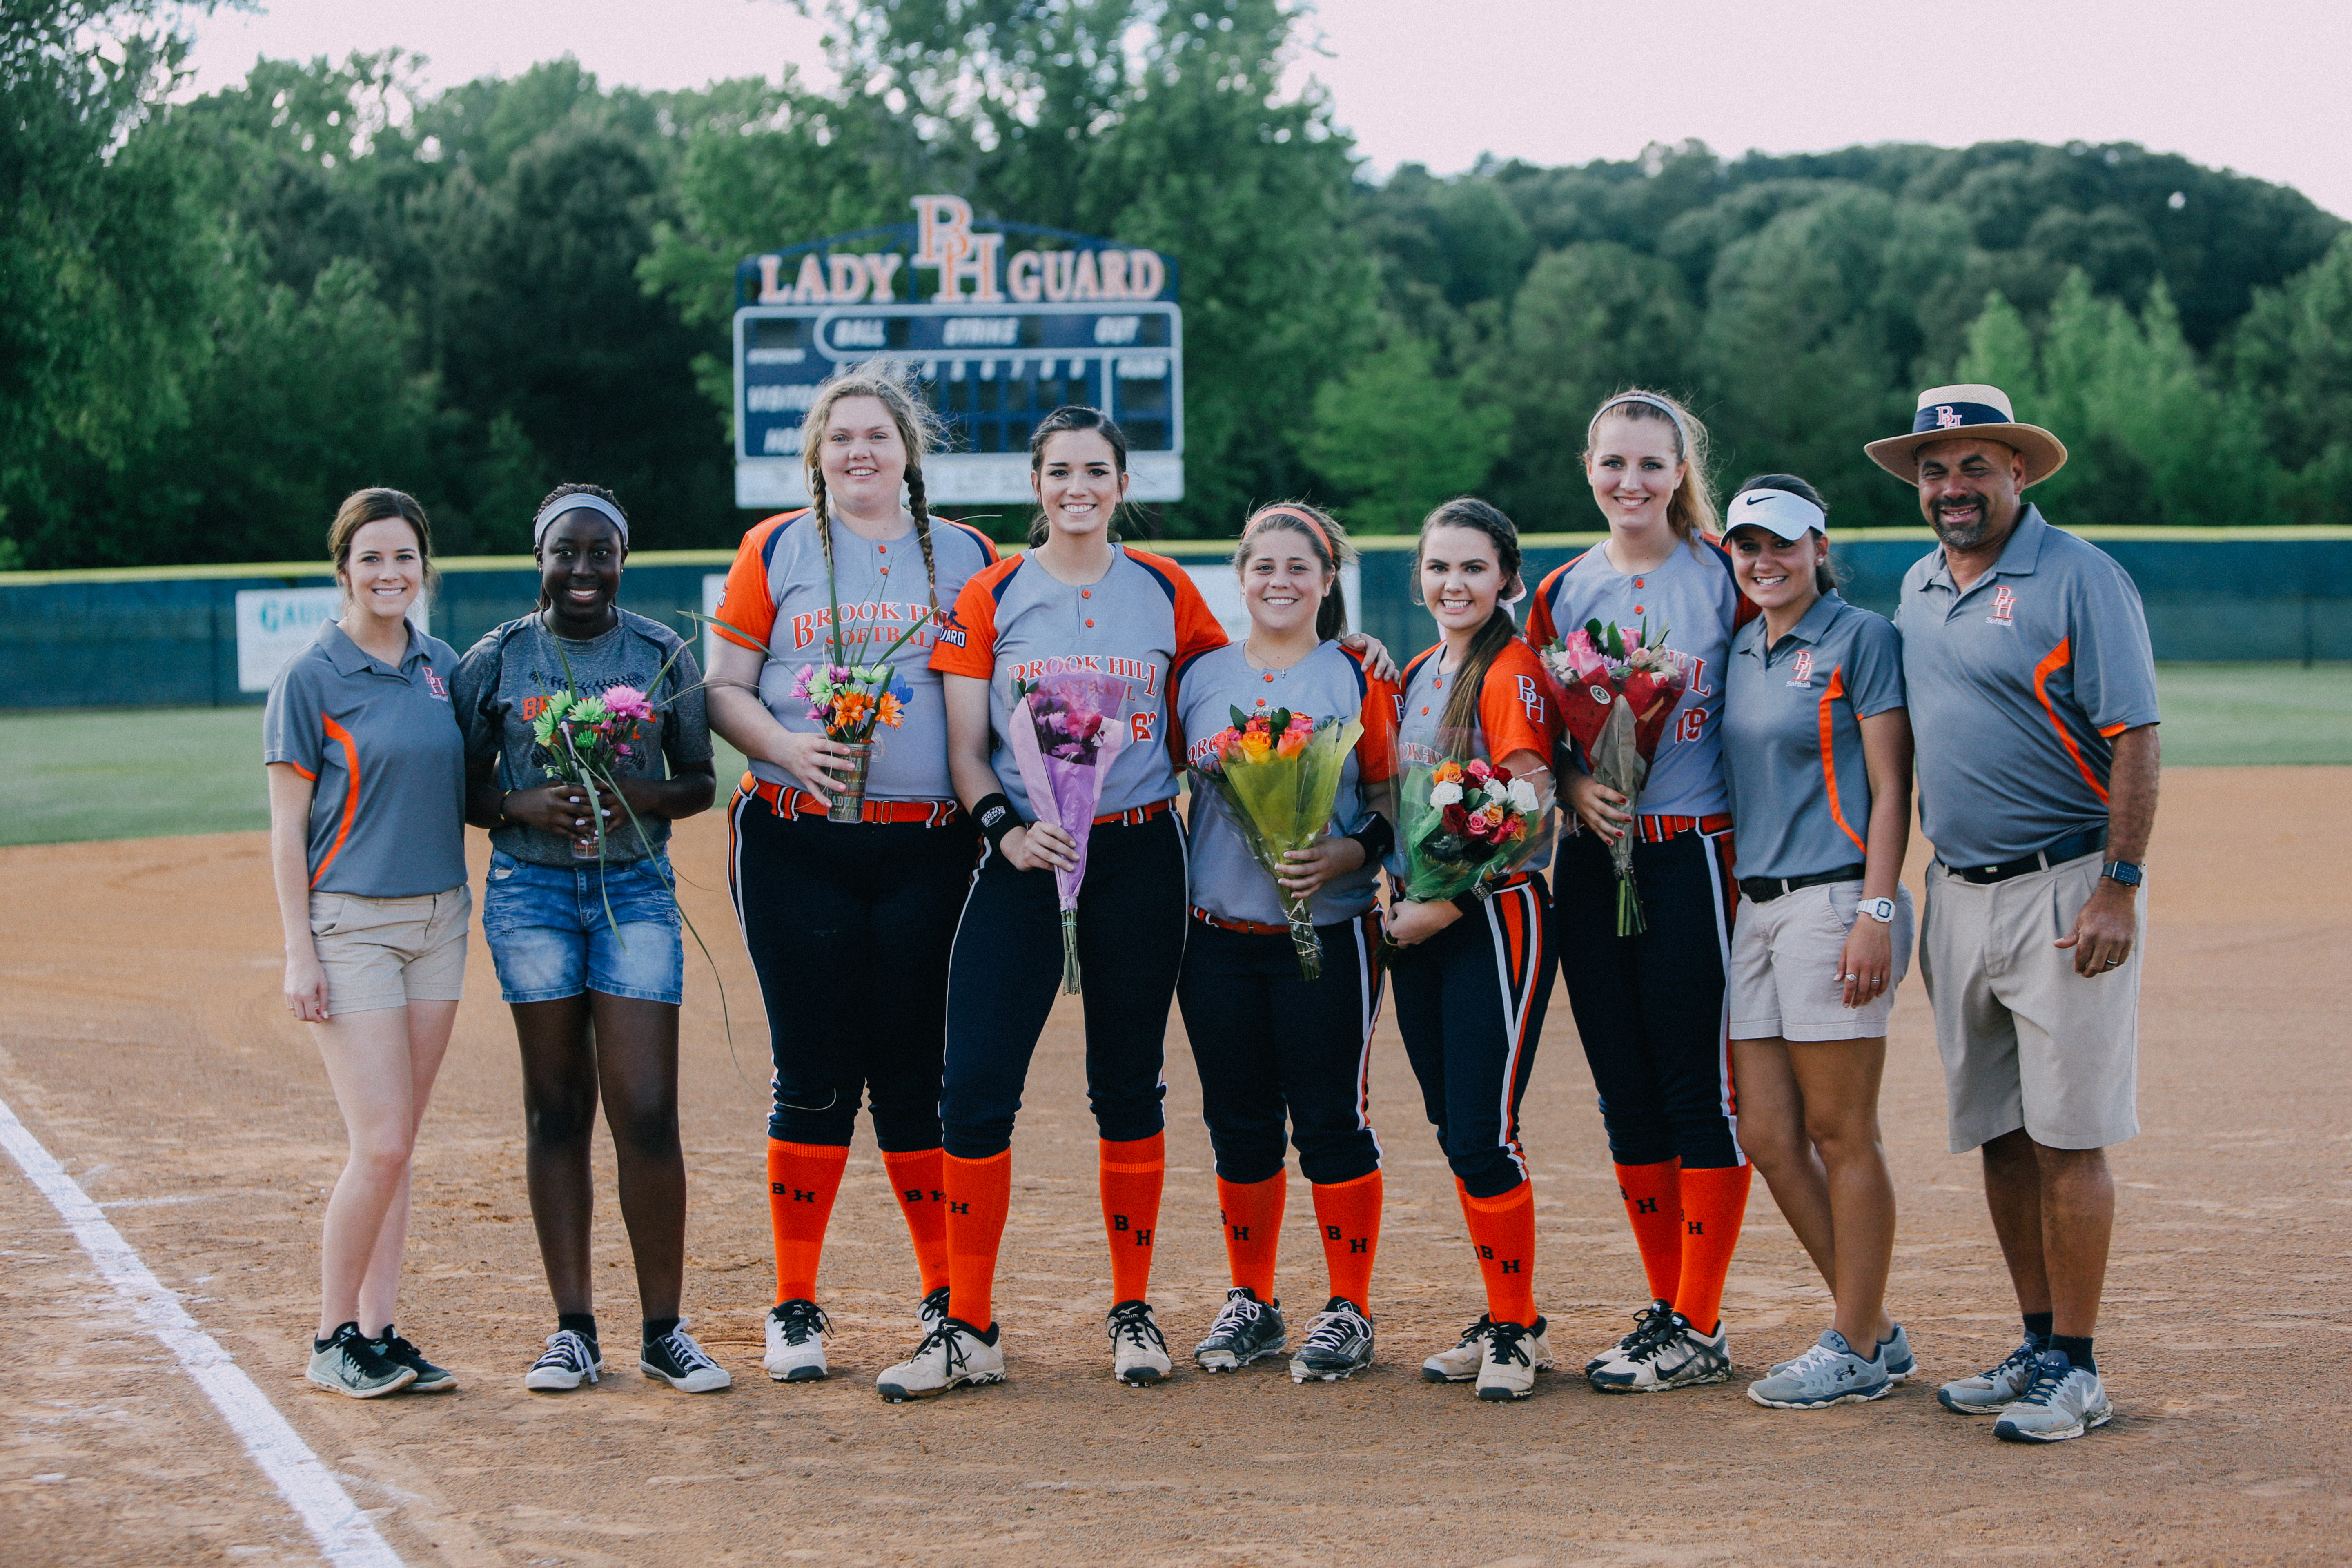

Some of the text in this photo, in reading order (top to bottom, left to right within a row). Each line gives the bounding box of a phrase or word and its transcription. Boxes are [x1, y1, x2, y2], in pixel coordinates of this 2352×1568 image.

[911, 194, 1005, 303] BH
[758, 248, 1165, 305] LADY GUARD
[1936, 405, 1962, 428] BH
[1990, 585, 2018, 620] BH
[791, 601, 904, 652] BROOK
[939, 628, 966, 648] UARD
[422, 666, 448, 695] BH
[1008, 654, 1158, 698] BROOK HILL
[1791, 650, 1815, 681] BH
[1514, 674, 1546, 724] BH
[1675, 707, 1710, 744] 19
[950, 1201, 969, 1215] H
